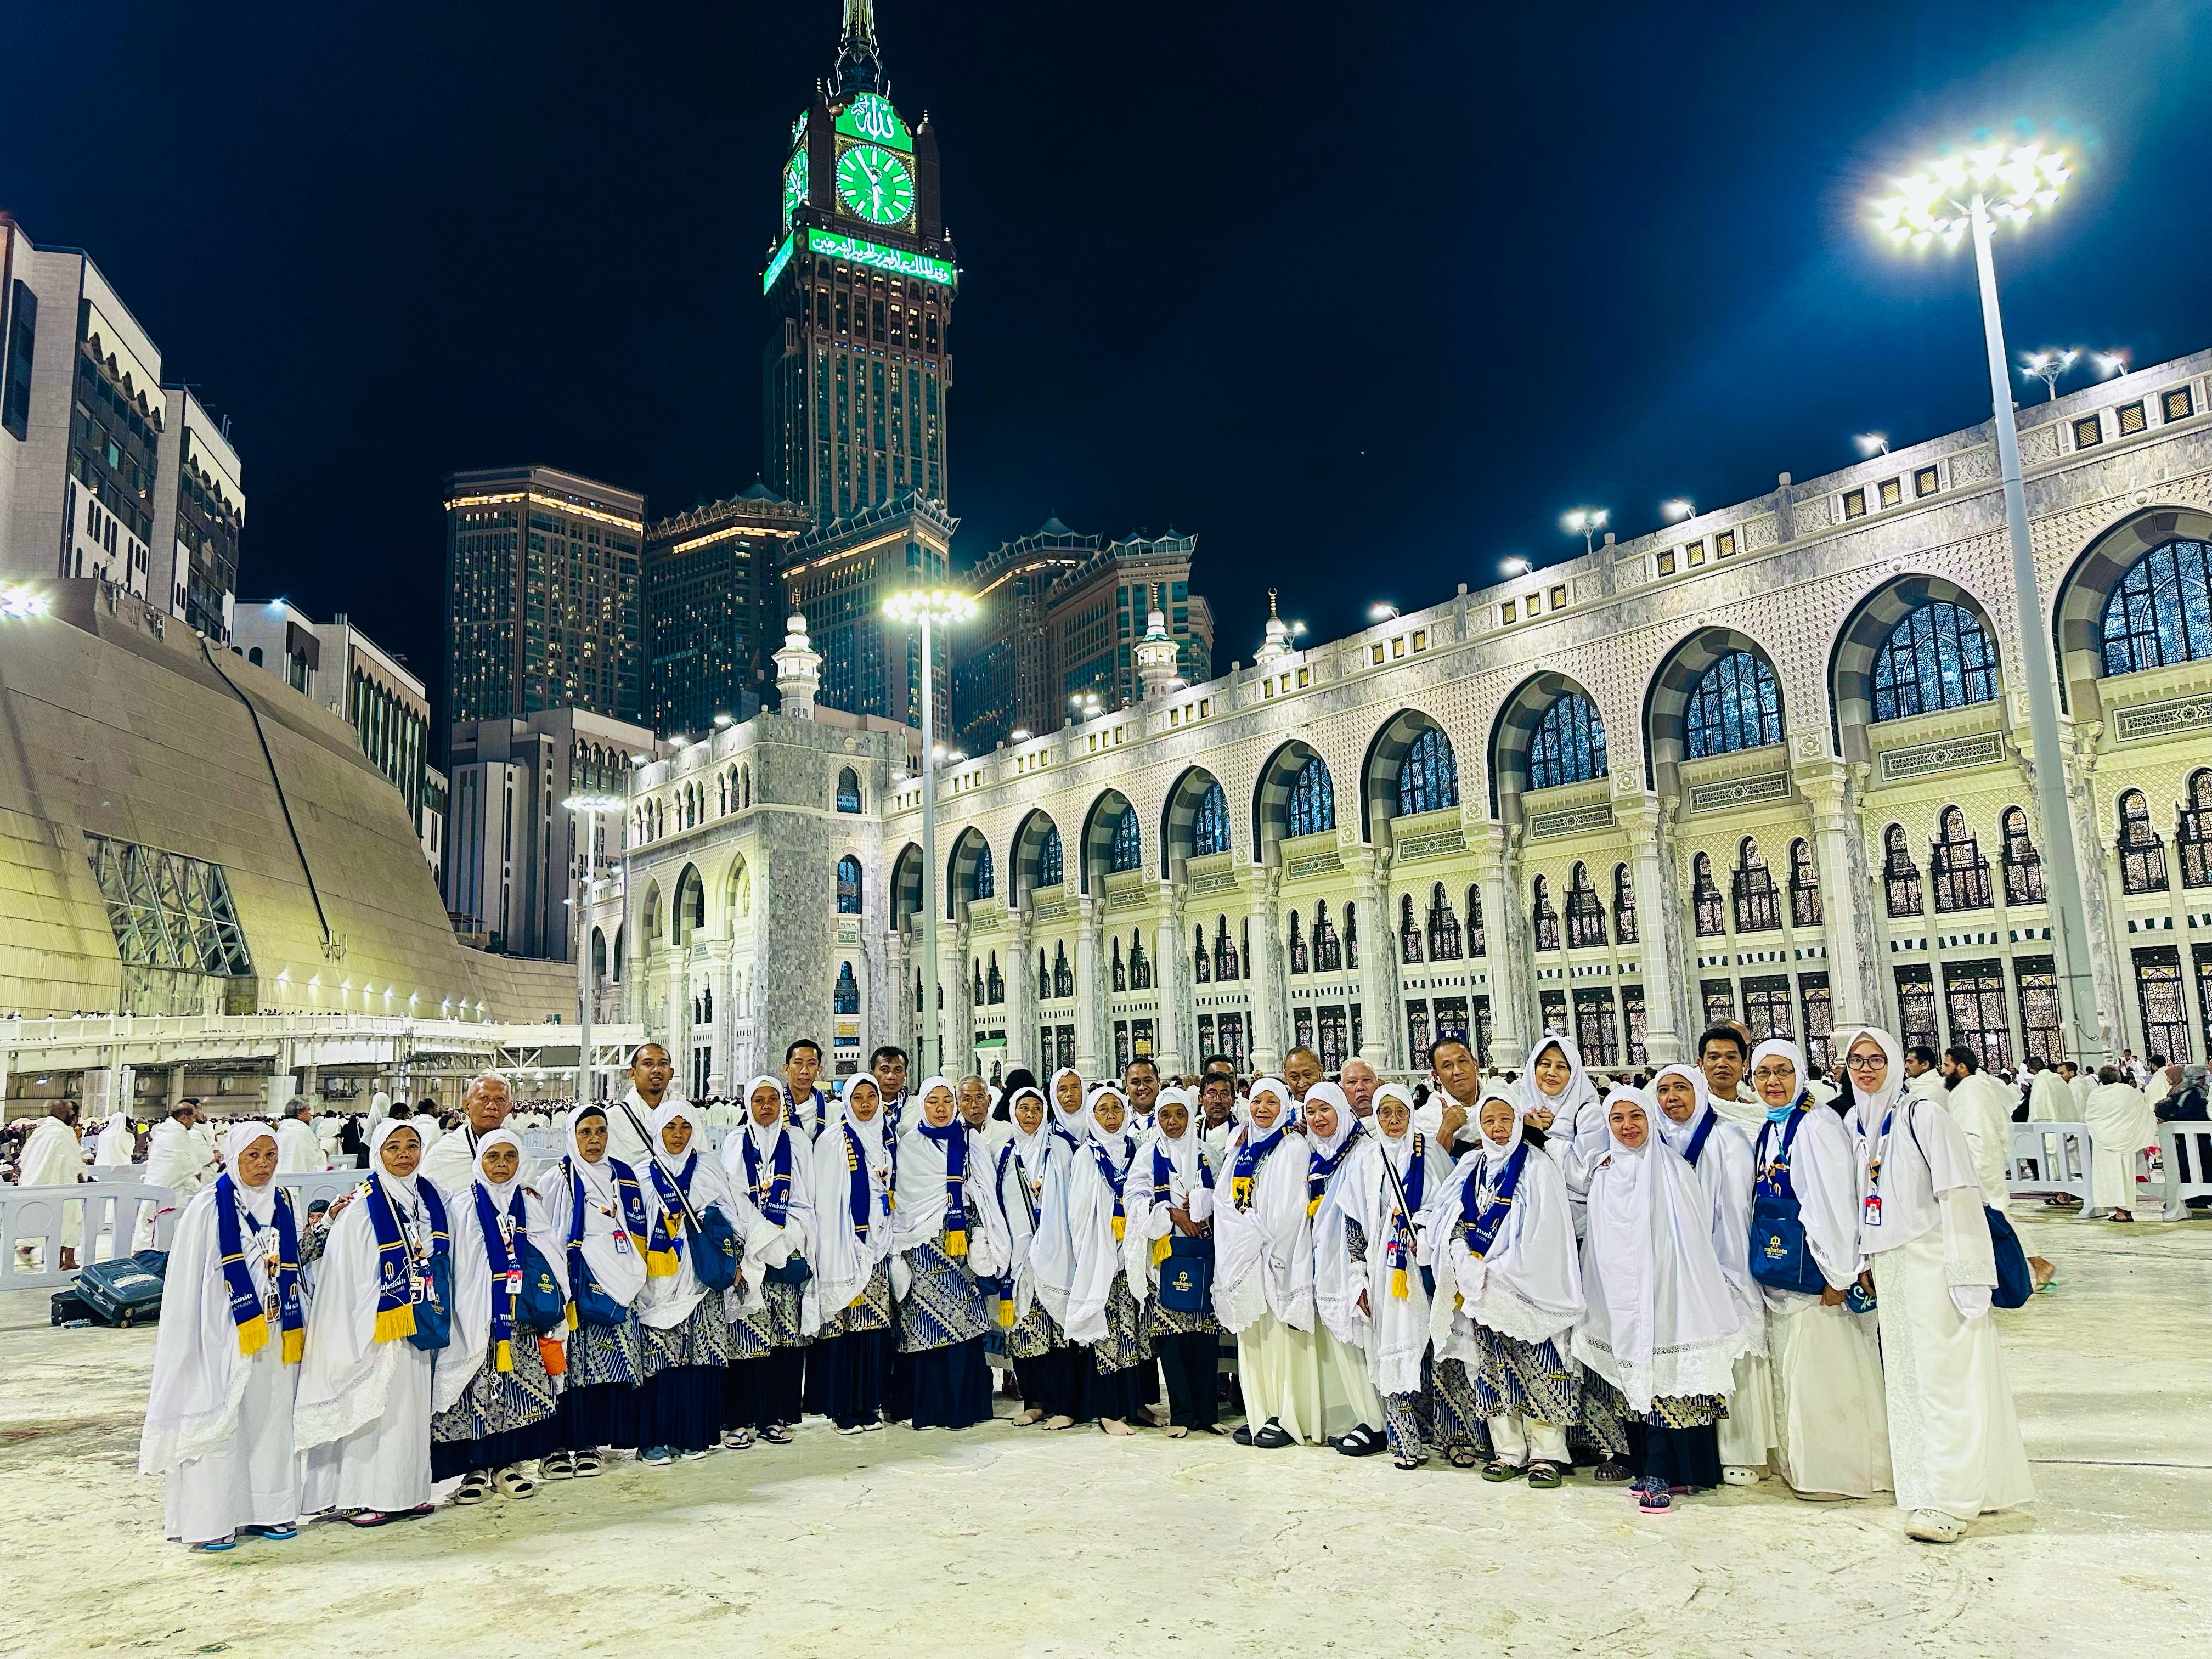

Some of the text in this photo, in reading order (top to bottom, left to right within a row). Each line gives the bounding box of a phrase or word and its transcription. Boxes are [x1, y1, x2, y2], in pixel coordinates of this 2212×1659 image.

[812, 237, 855, 255] الشريفين
[906, 255, 933, 274] الملك
[926, 267, 949, 283] وقف
